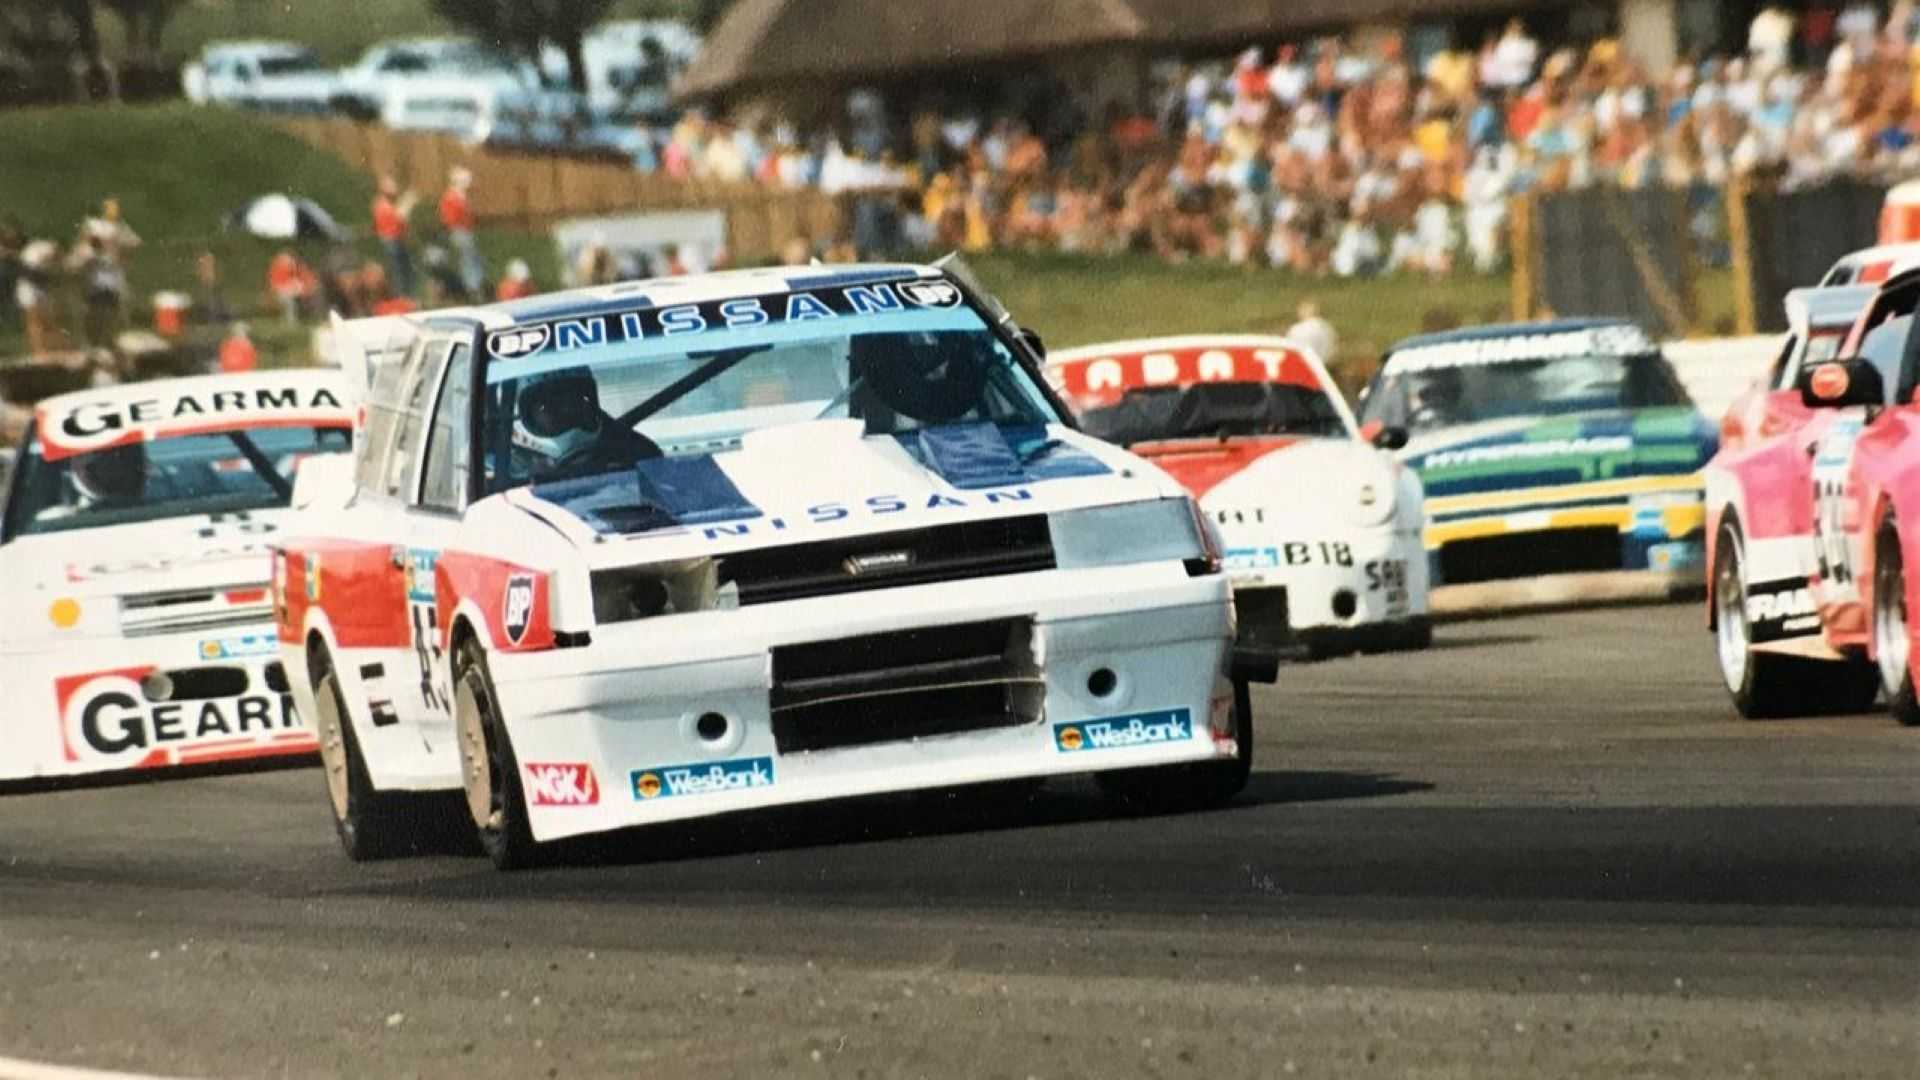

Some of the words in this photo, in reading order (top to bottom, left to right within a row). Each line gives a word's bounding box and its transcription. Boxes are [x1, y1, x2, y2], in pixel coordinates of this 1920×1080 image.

[498, 330, 544, 354] BP
[556, 283, 904, 350] NISSAN
[910, 286, 955, 304] BP
[704, 489, 1032, 539] NISSAN
[510, 586, 532, 629] BP
[1085, 713, 1188, 747] WesBank
[529, 764, 588, 804] NGK
[664, 761, 768, 795] WesBank
